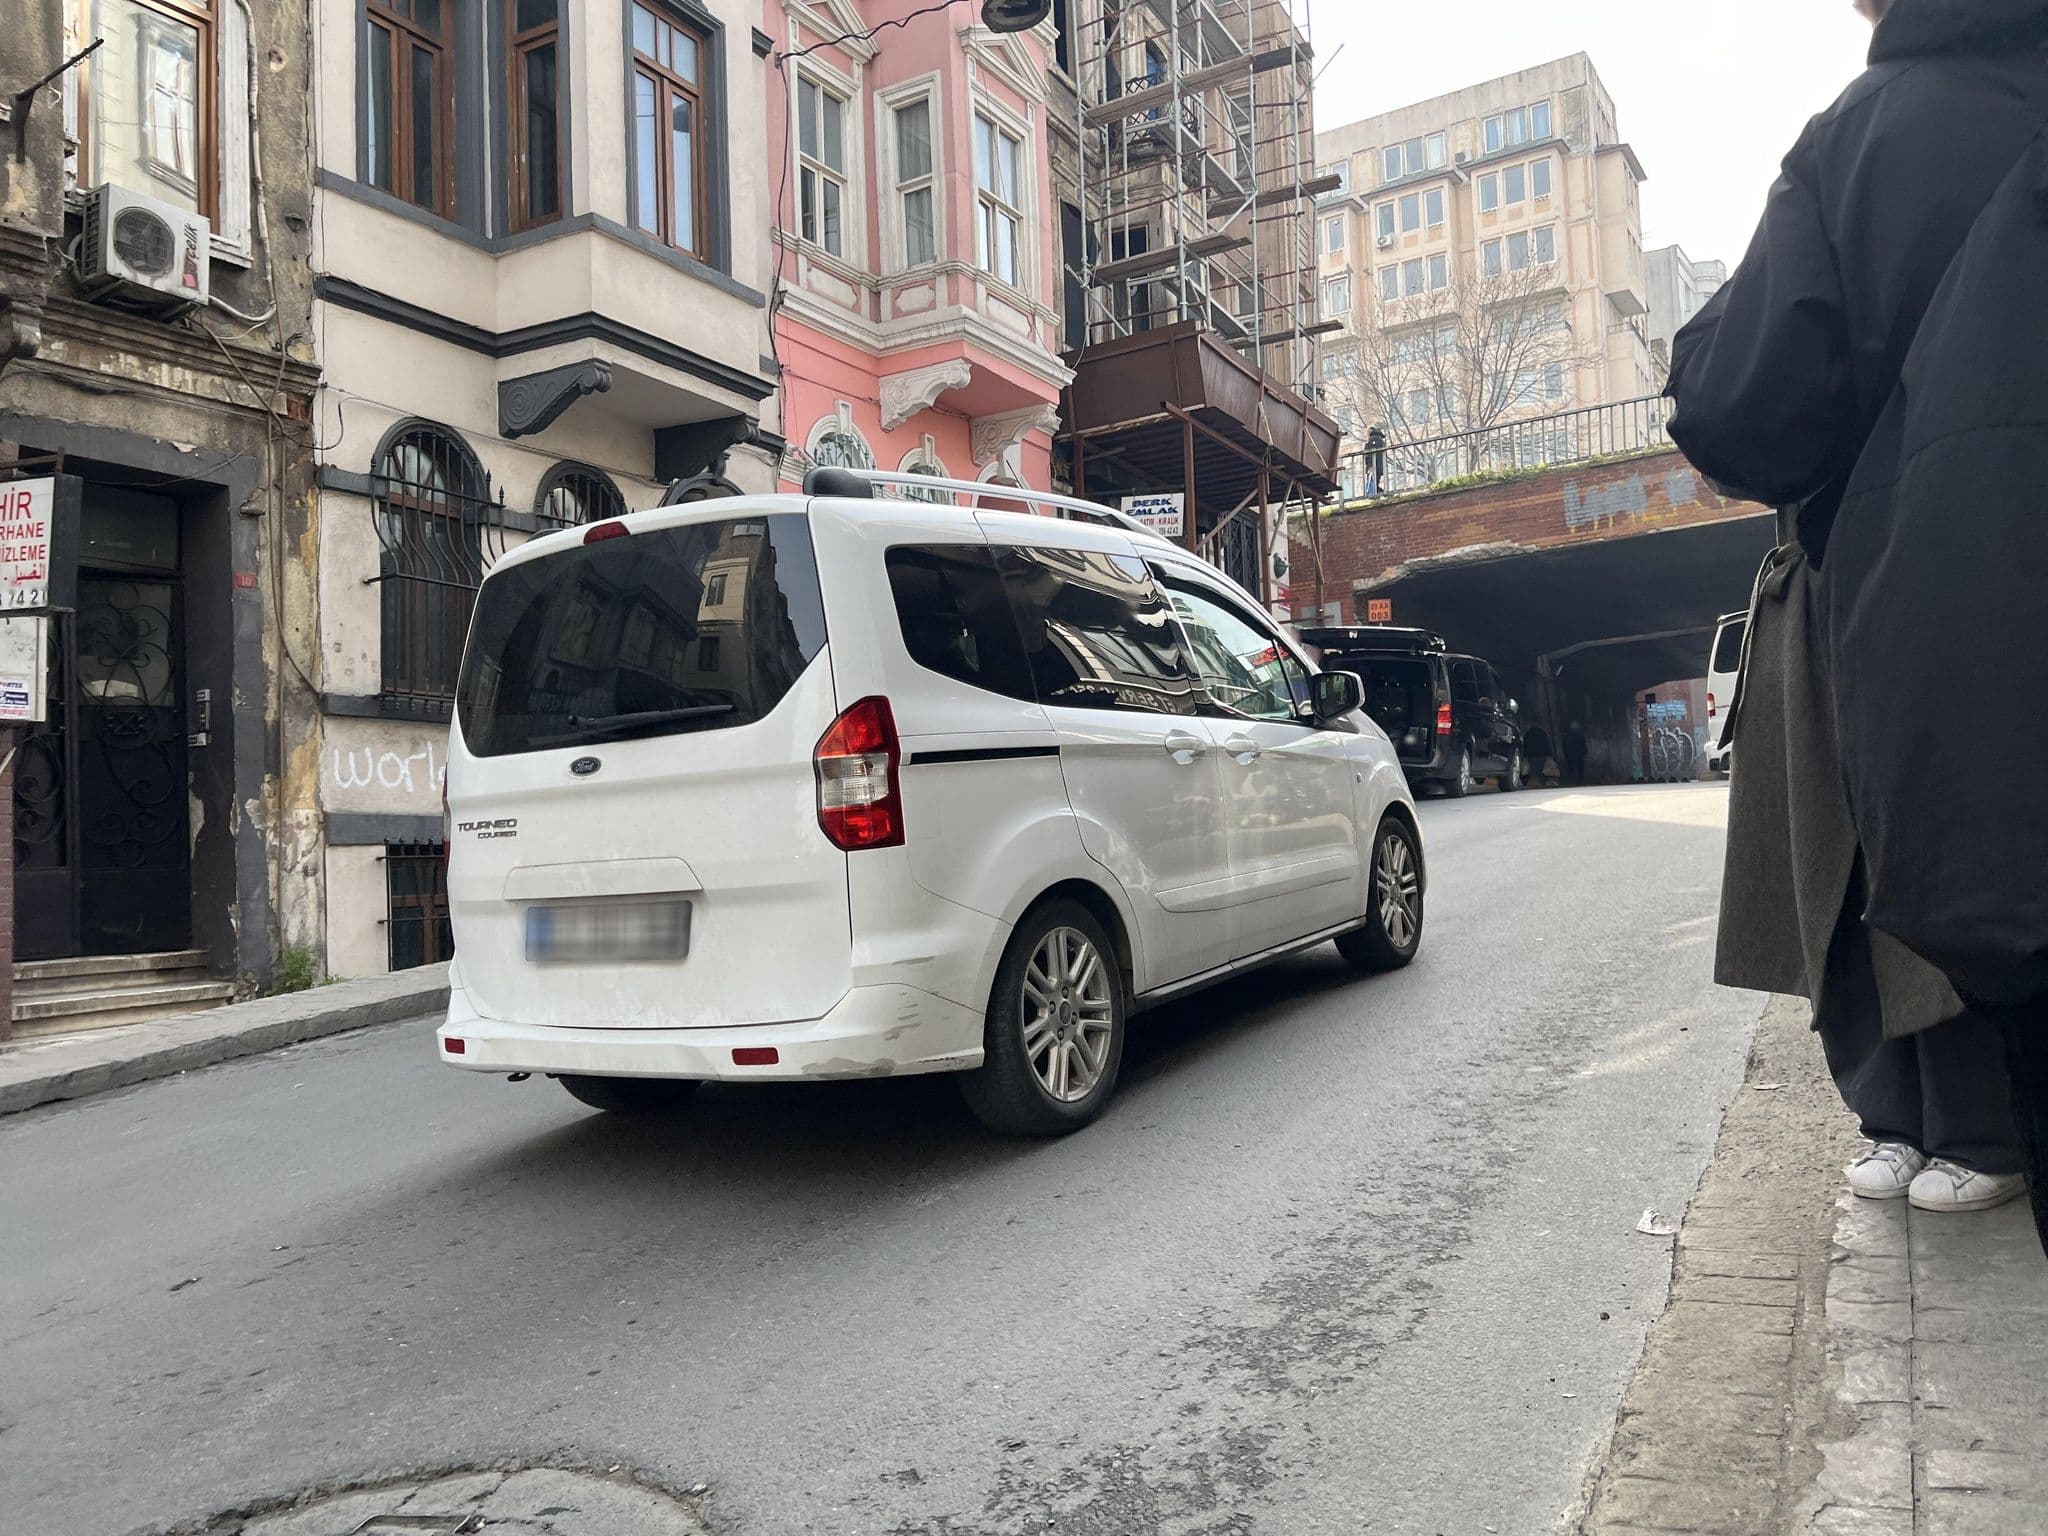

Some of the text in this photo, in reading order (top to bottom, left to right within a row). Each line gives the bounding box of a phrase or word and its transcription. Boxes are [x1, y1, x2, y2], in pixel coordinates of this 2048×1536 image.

[1132, 498, 1172, 508] BERK
[1125, 506, 1179, 517] EMLAK
[0, 543, 46, 563] İZLEME
[334, 740, 446, 792] worl
[457, 818, 518, 832] TOURNEO
[477, 831, 517, 839] COURIER
